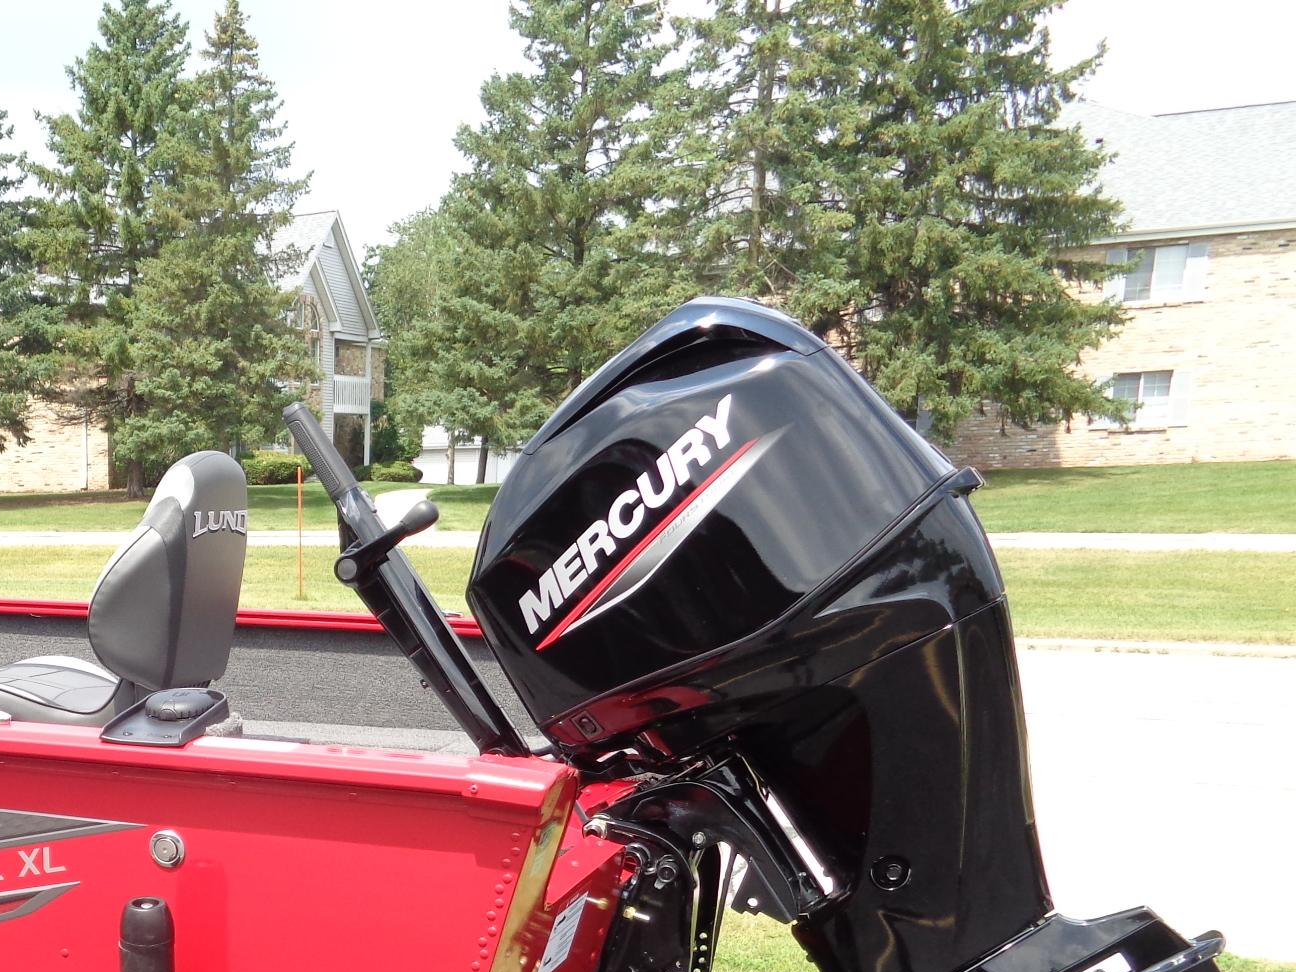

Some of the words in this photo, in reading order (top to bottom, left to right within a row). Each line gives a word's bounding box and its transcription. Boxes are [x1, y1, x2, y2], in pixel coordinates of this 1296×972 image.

[192, 510, 248, 538] LUND
[518, 393, 732, 635] MERCURY
[17, 846, 67, 878] XL
